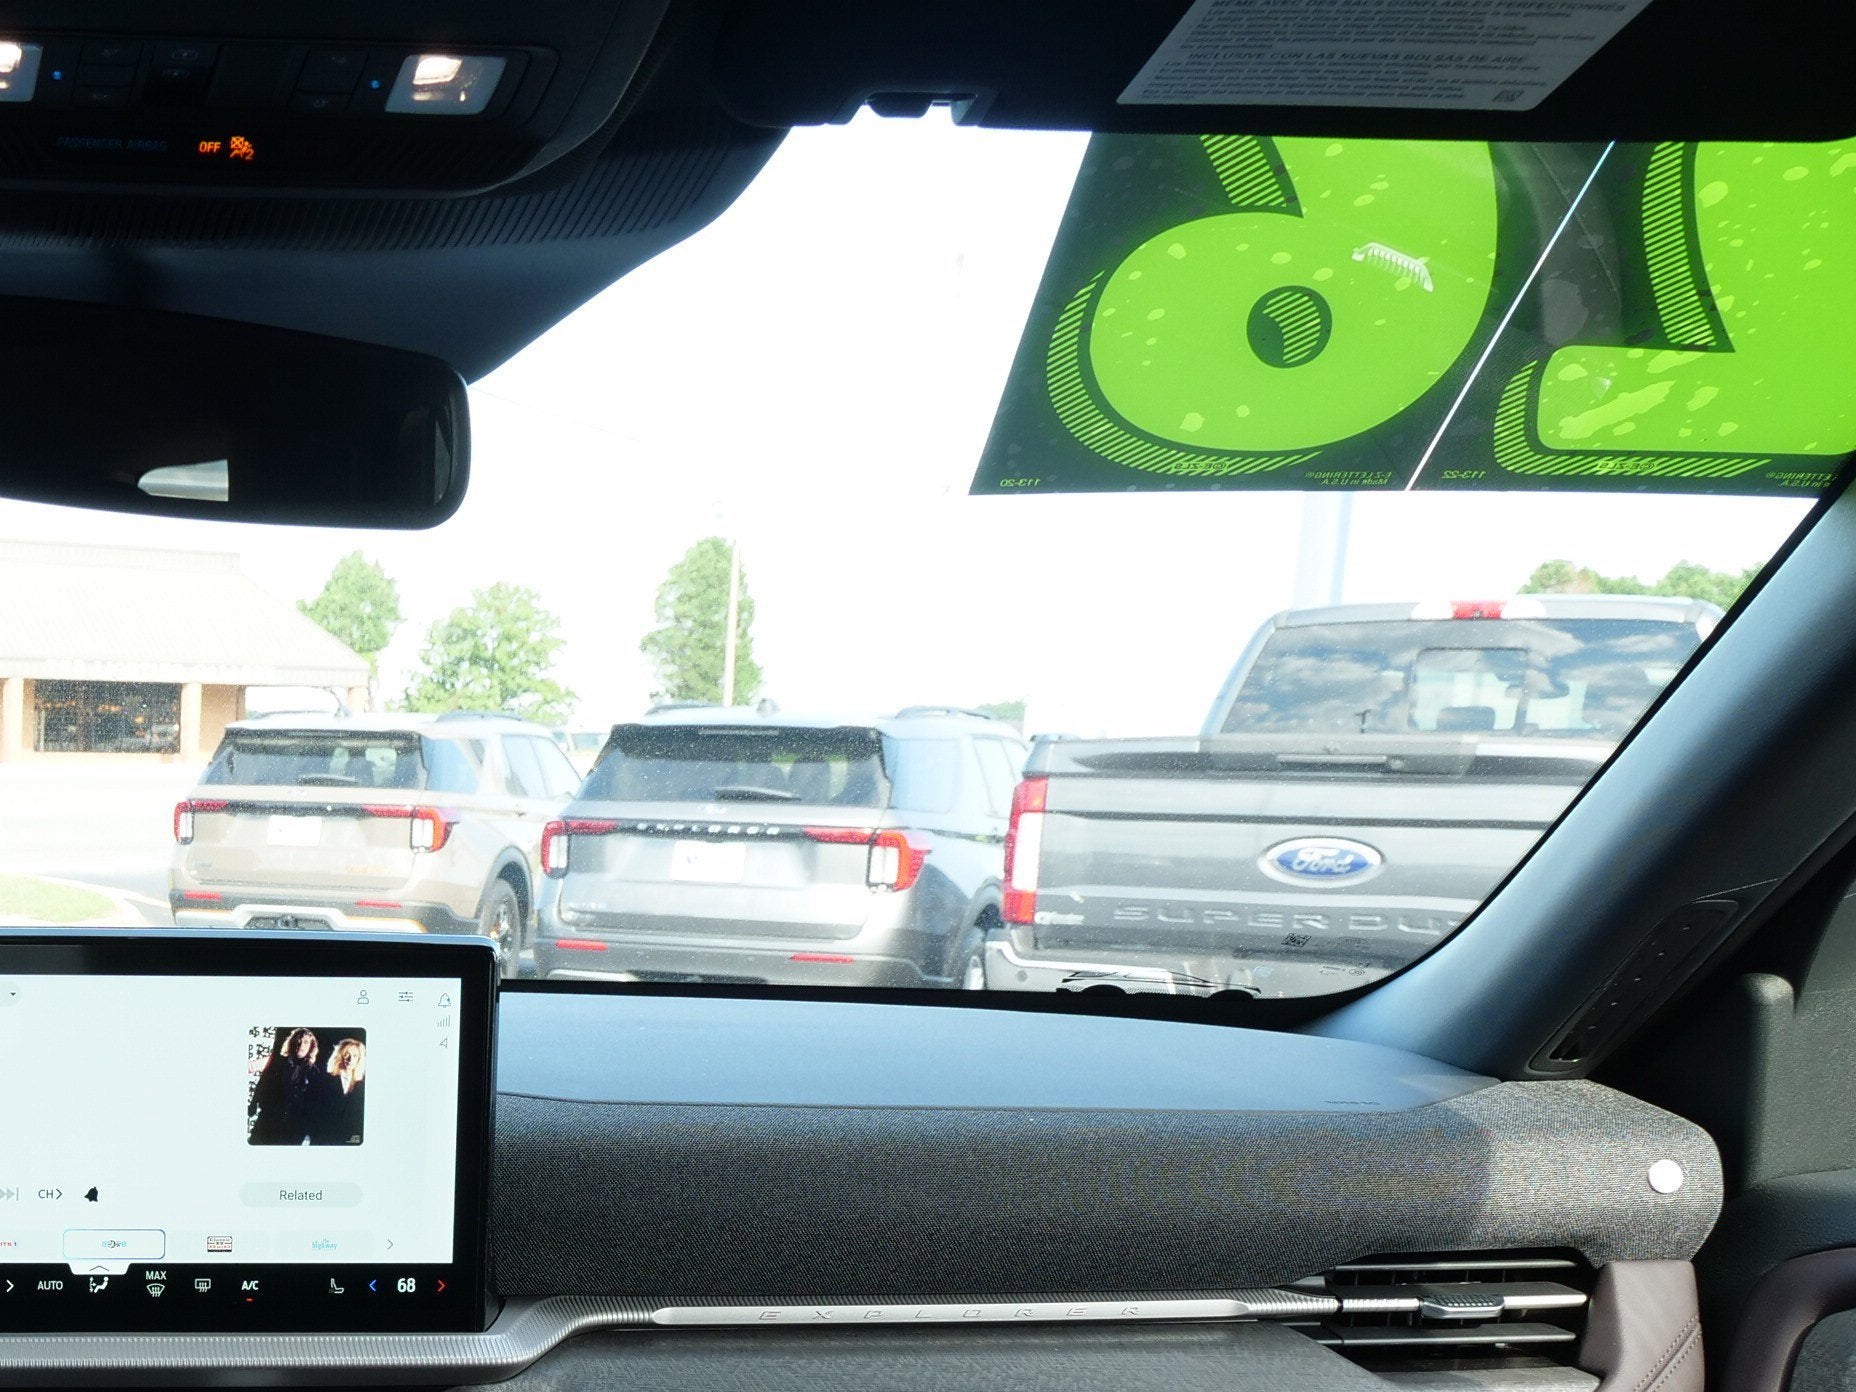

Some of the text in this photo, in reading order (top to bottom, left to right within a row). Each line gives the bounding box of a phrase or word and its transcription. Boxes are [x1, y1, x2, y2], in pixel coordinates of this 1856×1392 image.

[198, 141, 222, 153] OFF
[1113, 906, 1330, 930] SUPER
[38, 1189, 54, 1199] CH
[279, 1189, 323, 1201] Related
[145, 1270, 167, 1281] MAX
[36, 1280, 63, 1290] AUTO
[241, 1280, 260, 1290] A/C
[397, 1278, 416, 1293] 68
